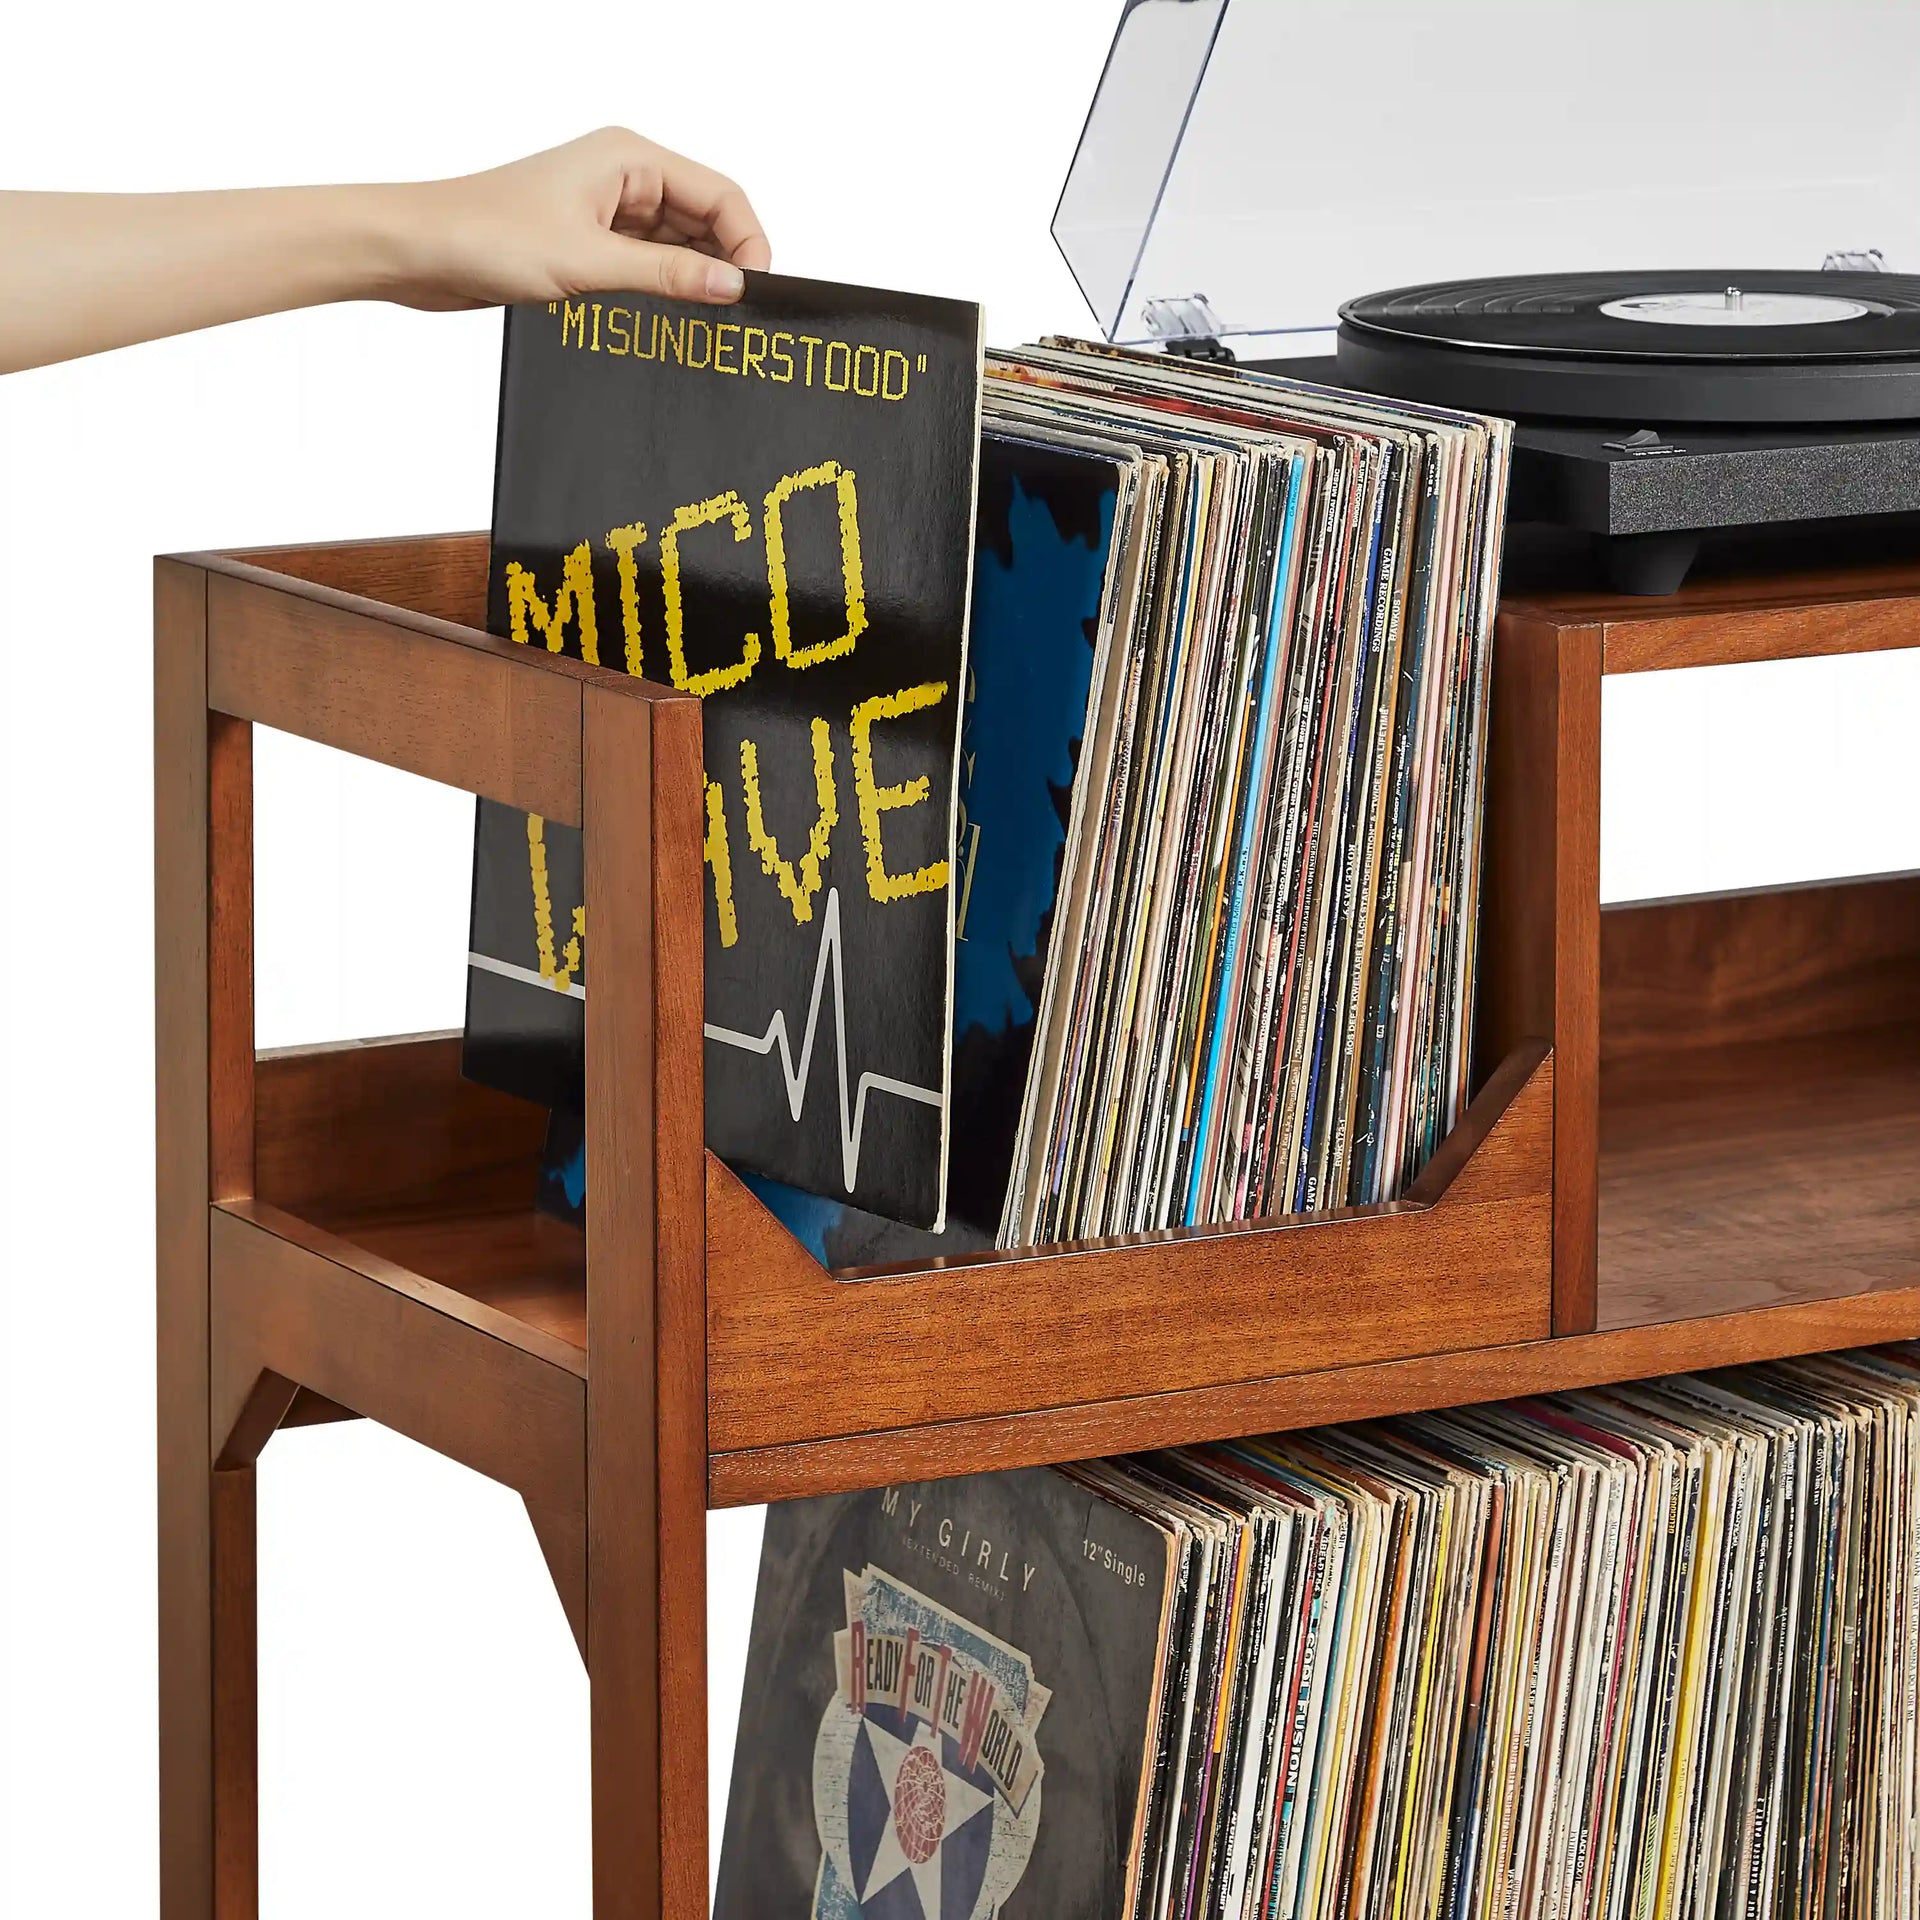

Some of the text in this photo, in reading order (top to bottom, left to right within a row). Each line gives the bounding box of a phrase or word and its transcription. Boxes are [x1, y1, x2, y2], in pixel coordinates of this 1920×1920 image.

[547, 299, 928, 401] "MISUNDERSTOOD"
[1356, 459, 1367, 483] BLUNT
[1324, 467, 1342, 533] BANDAI MUSIC
[1370, 546, 1393, 653] GAME RECORDINGS
[1343, 843, 1356, 882] ROYCE
[1295, 821, 1320, 969] MIC GERONIMO WHEREVER YOU ARE
[1342, 882, 1351, 898] DA
[1359, 886, 1369, 913] STAR
[1355, 913, 1367, 948] BLACK
[1353, 948, 1363, 970] ARE
[1301, 990, 1309, 1004] the
[1349, 970, 1361, 1002] KWELI
[1346, 1012, 1356, 1031] DEF
[1344, 1032, 1354, 1056] MOS
[1252, 1052, 1262, 1080] DRUM
[1305, 1176, 1316, 1203] GAM
[1667, 1495, 1677, 1533] DELICIOUS
[880, 1486, 1036, 1592] MY GIRLY
[1551, 1526, 1564, 1568] TOMMY BOY
[1082, 1538, 1103, 1562] 12"
[1104, 1549, 1146, 1587] Single
[1908, 1674, 1915, 1686] DO
[851, 1621, 1023, 1791] READY FOR THE WORLD
[1285, 1699, 1308, 1787] FUSION
[1753, 1808, 1764, 1837] PARTY
[1578, 1828, 1588, 1855] BLACK
[1749, 1842, 1761, 1884] GANGSTA
[1502, 1867, 1515, 1907] VESTRON
